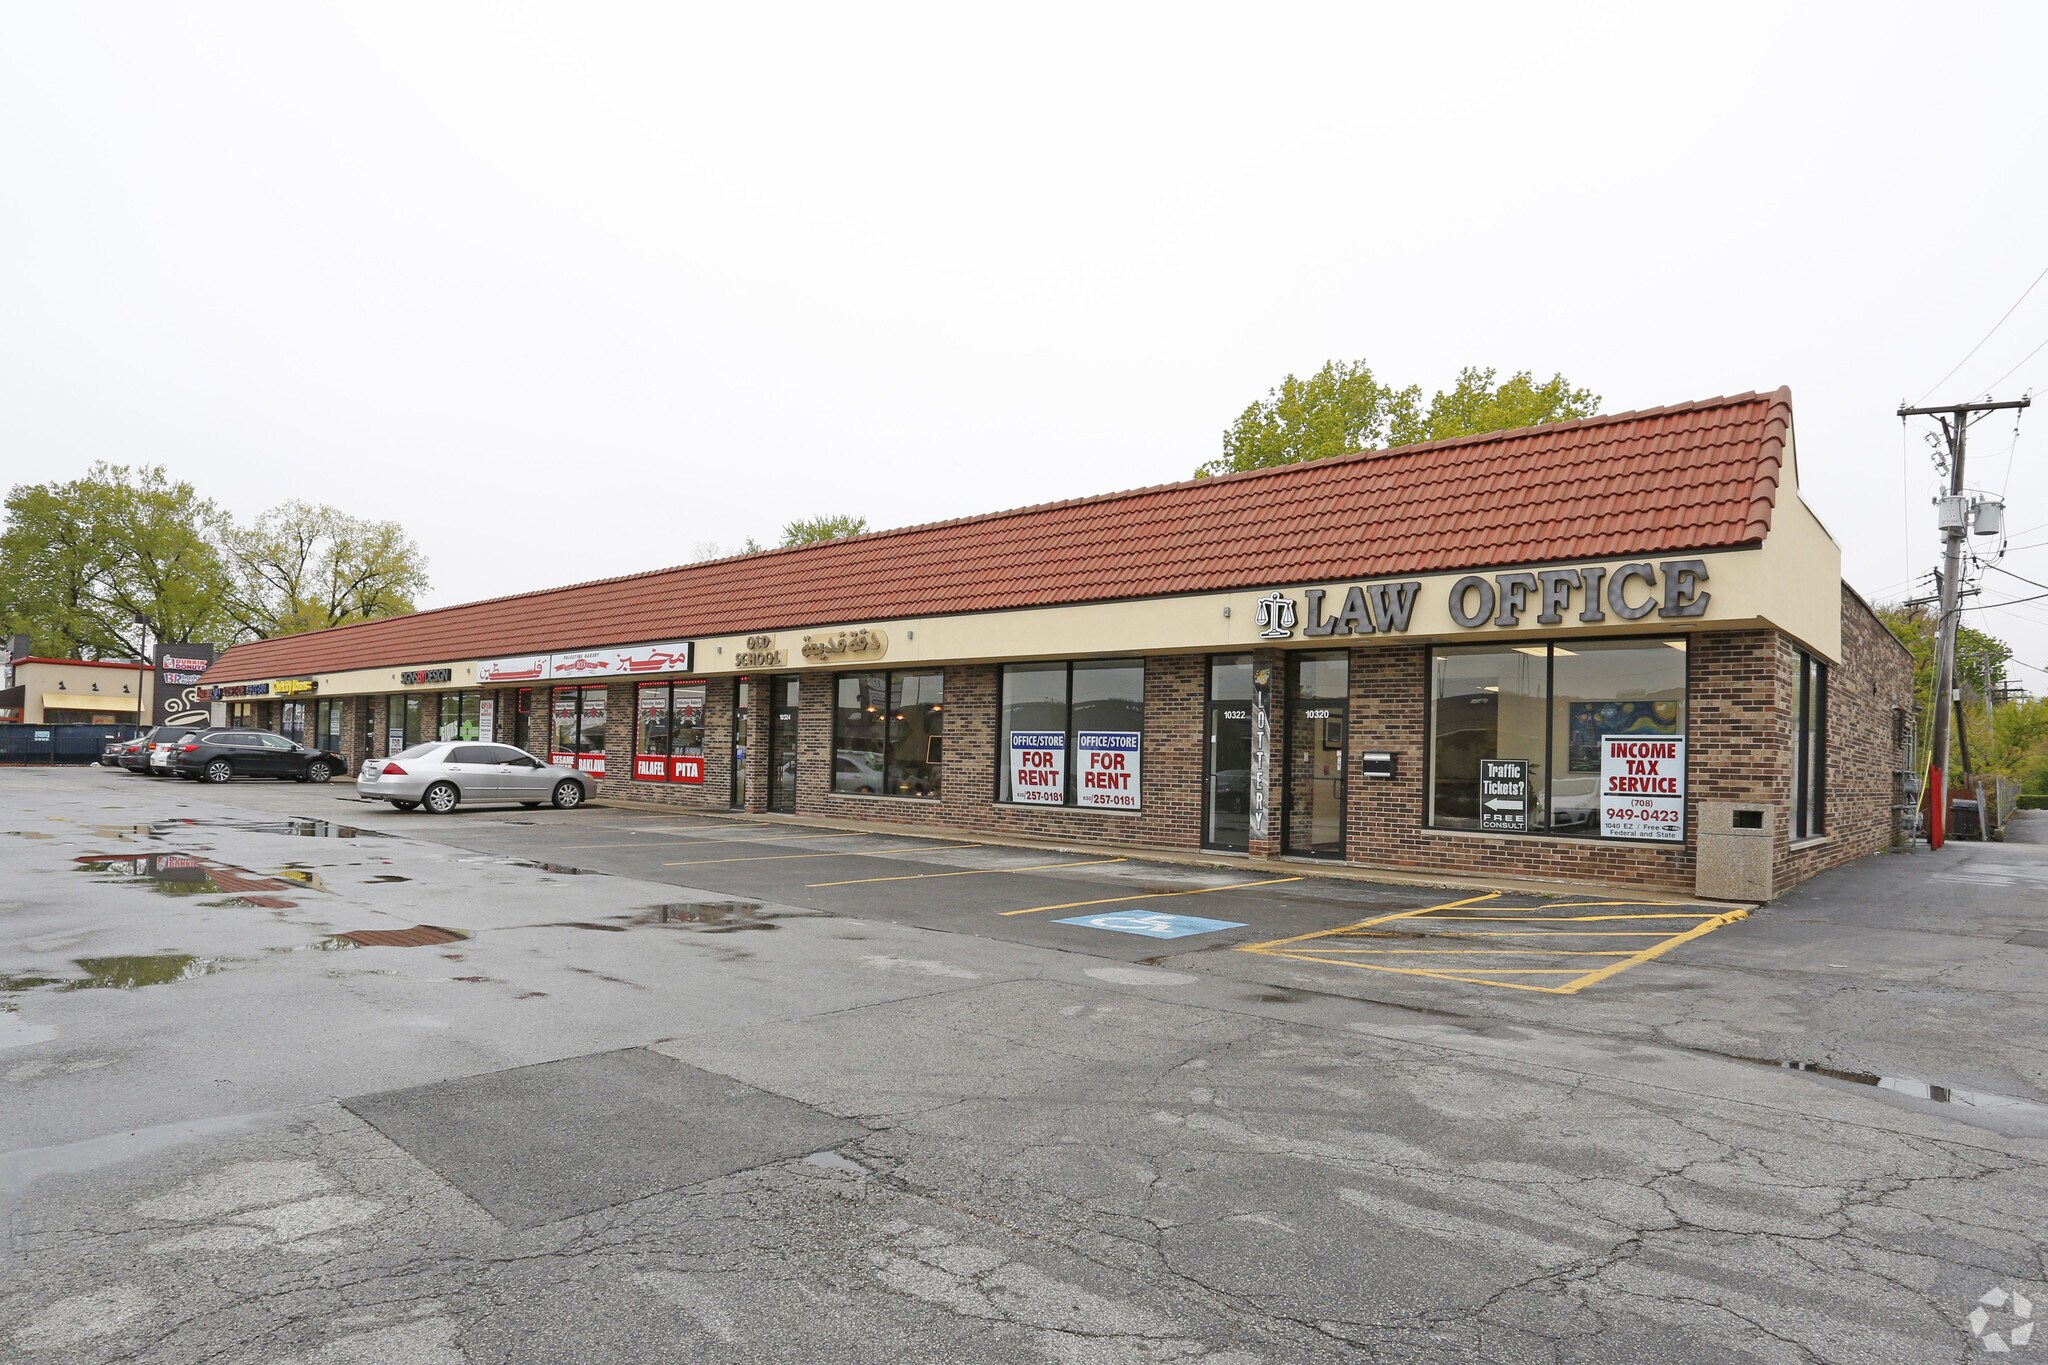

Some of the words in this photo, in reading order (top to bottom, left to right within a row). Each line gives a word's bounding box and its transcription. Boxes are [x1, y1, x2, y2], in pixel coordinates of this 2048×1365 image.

[1303, 582, 1421, 637] LAW
[1448, 559, 1711, 628] OFFICE
[746, 635, 771, 651] OLD
[616, 648, 686, 672] مخبز
[735, 650, 781, 667] SCHOOL
[479, 658, 547, 680] فلسطين
[1223, 711, 1246, 720] 10322
[1305, 709, 1329, 719] 10320
[1013, 735, 1064, 747] OFFICE/STORE
[1080, 735, 1137, 748] OFFICE/STORE
[1610, 742, 1676, 759] INCOME
[552, 755, 574, 765] SESAME
[579, 758, 605, 772] BAKLAVA
[1022, 751, 1054, 768] FOR
[1090, 752, 1125, 770] FOR
[1255, 691, 1264, 830] LOTTERY
[1626, 759, 1659, 775] TAX
[638, 760, 665, 776] FALAFEL
[675, 762, 698, 778] PITA
[1487, 763, 1521, 779] Traffic
[1018, 769, 1059, 786] RENT
[1085, 772, 1131, 790] RENT
[1609, 776, 1677, 793] SERVICE
[1483, 780, 1525, 796] Tickets?
[1631, 799, 1653, 808] (708)
[1483, 813, 1524, 822] FREE
[1606, 808, 1679, 822] 949-0423
[1483, 821, 1524, 830] CONSULT
[1609, 829, 1637, 837] Federal
[1656, 831, 1676, 839] State
